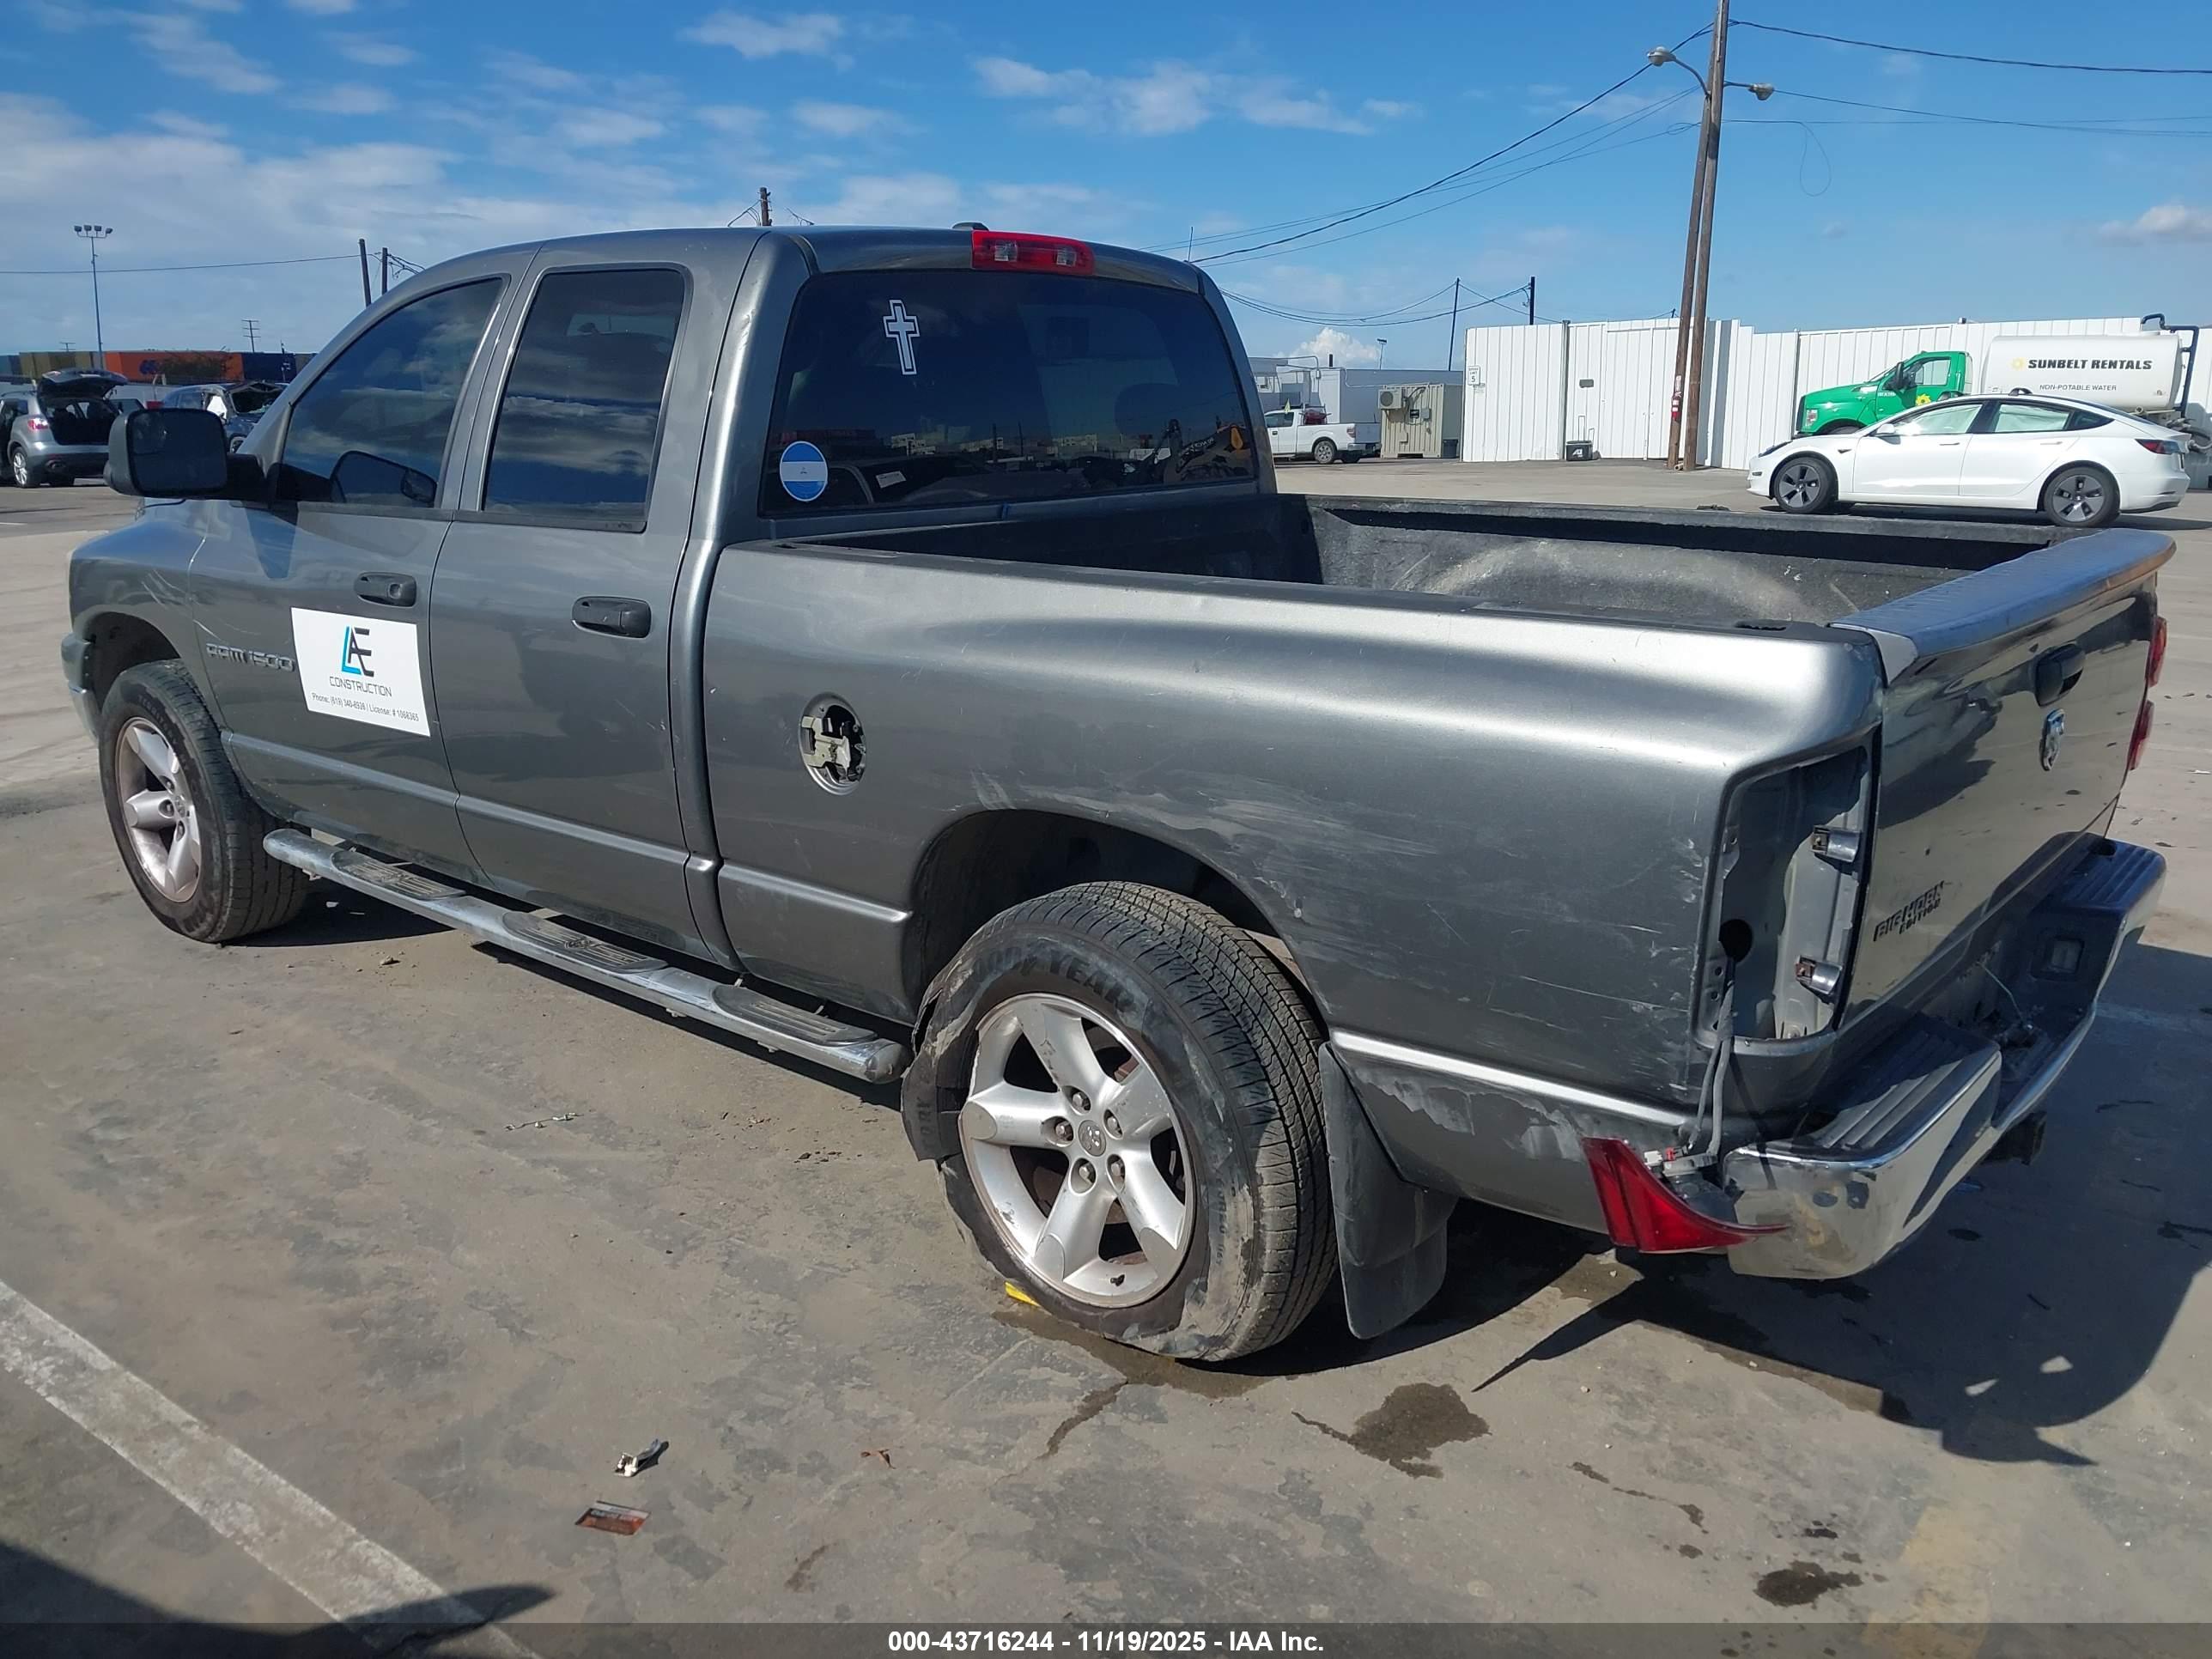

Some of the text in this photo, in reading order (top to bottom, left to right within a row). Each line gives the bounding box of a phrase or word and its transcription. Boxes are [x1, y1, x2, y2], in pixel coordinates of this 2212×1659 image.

[2027, 359, 2153, 370] SUNBELT RENTALS
[205, 643, 295, 672] RAM 1500
[329, 676, 392, 697] CONSTRUCTION
[369, 703, 392, 716] License:
